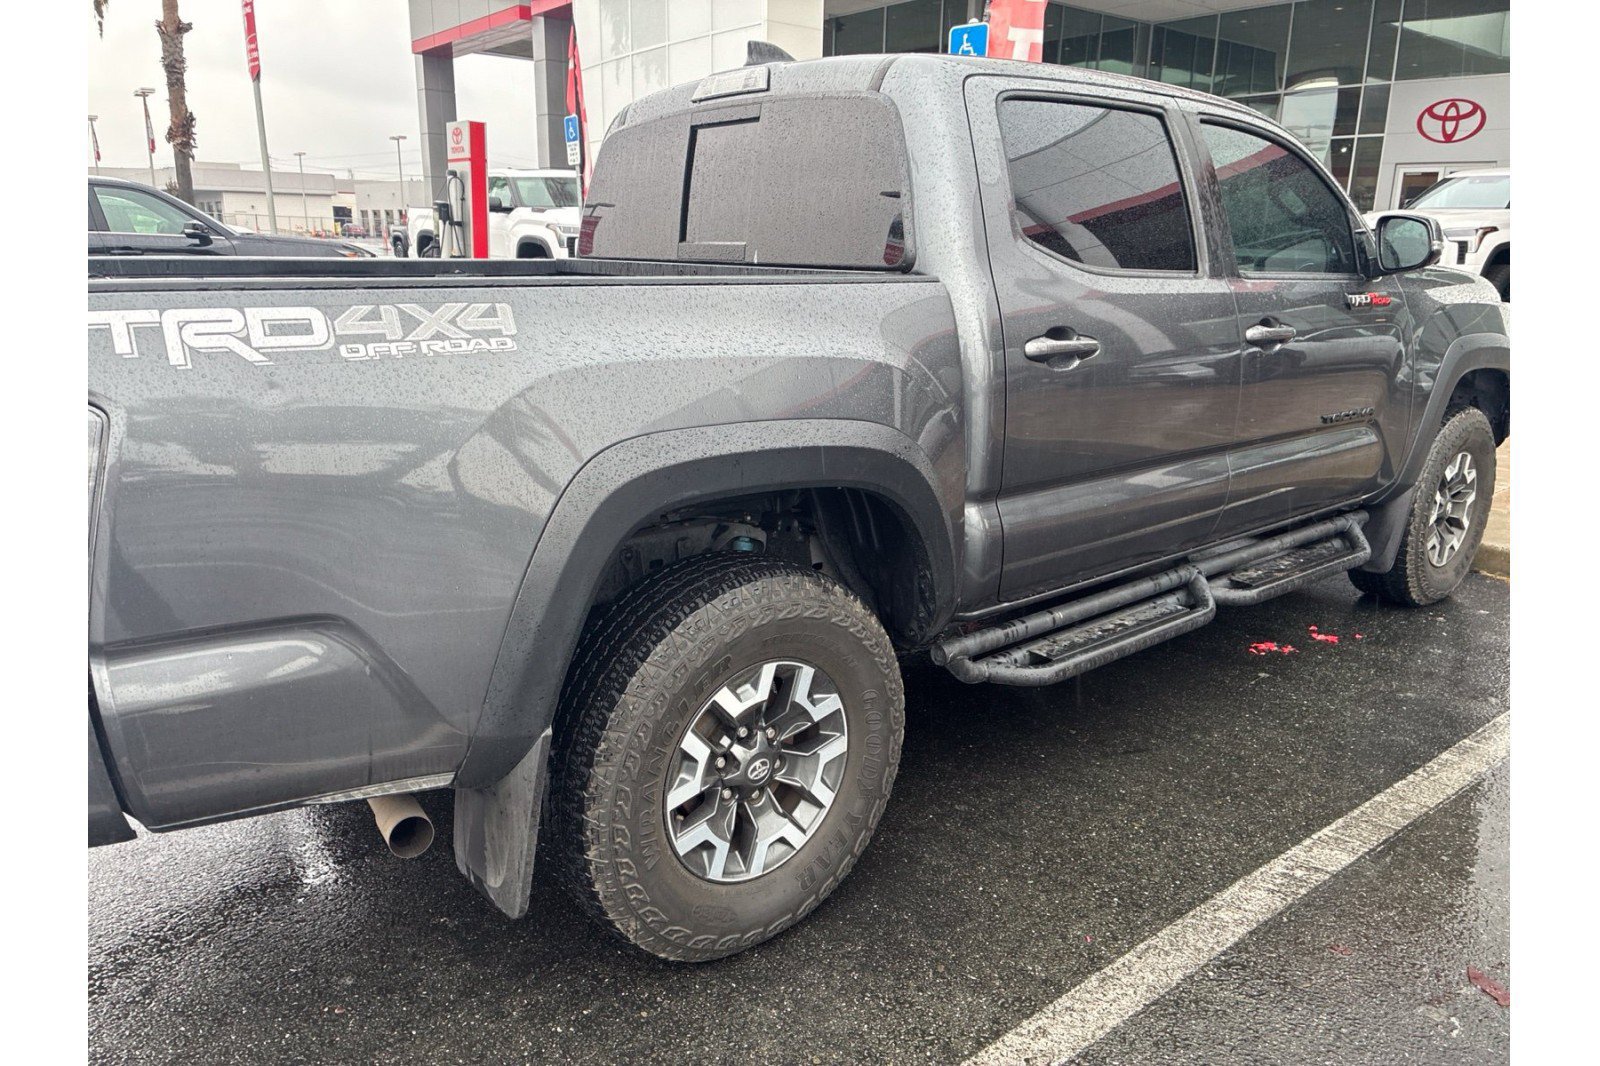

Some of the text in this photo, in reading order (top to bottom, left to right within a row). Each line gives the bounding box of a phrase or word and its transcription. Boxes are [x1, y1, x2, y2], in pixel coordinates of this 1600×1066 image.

[88, 306, 335, 369] TRD
[339, 337, 518, 362] OFF ROAD
